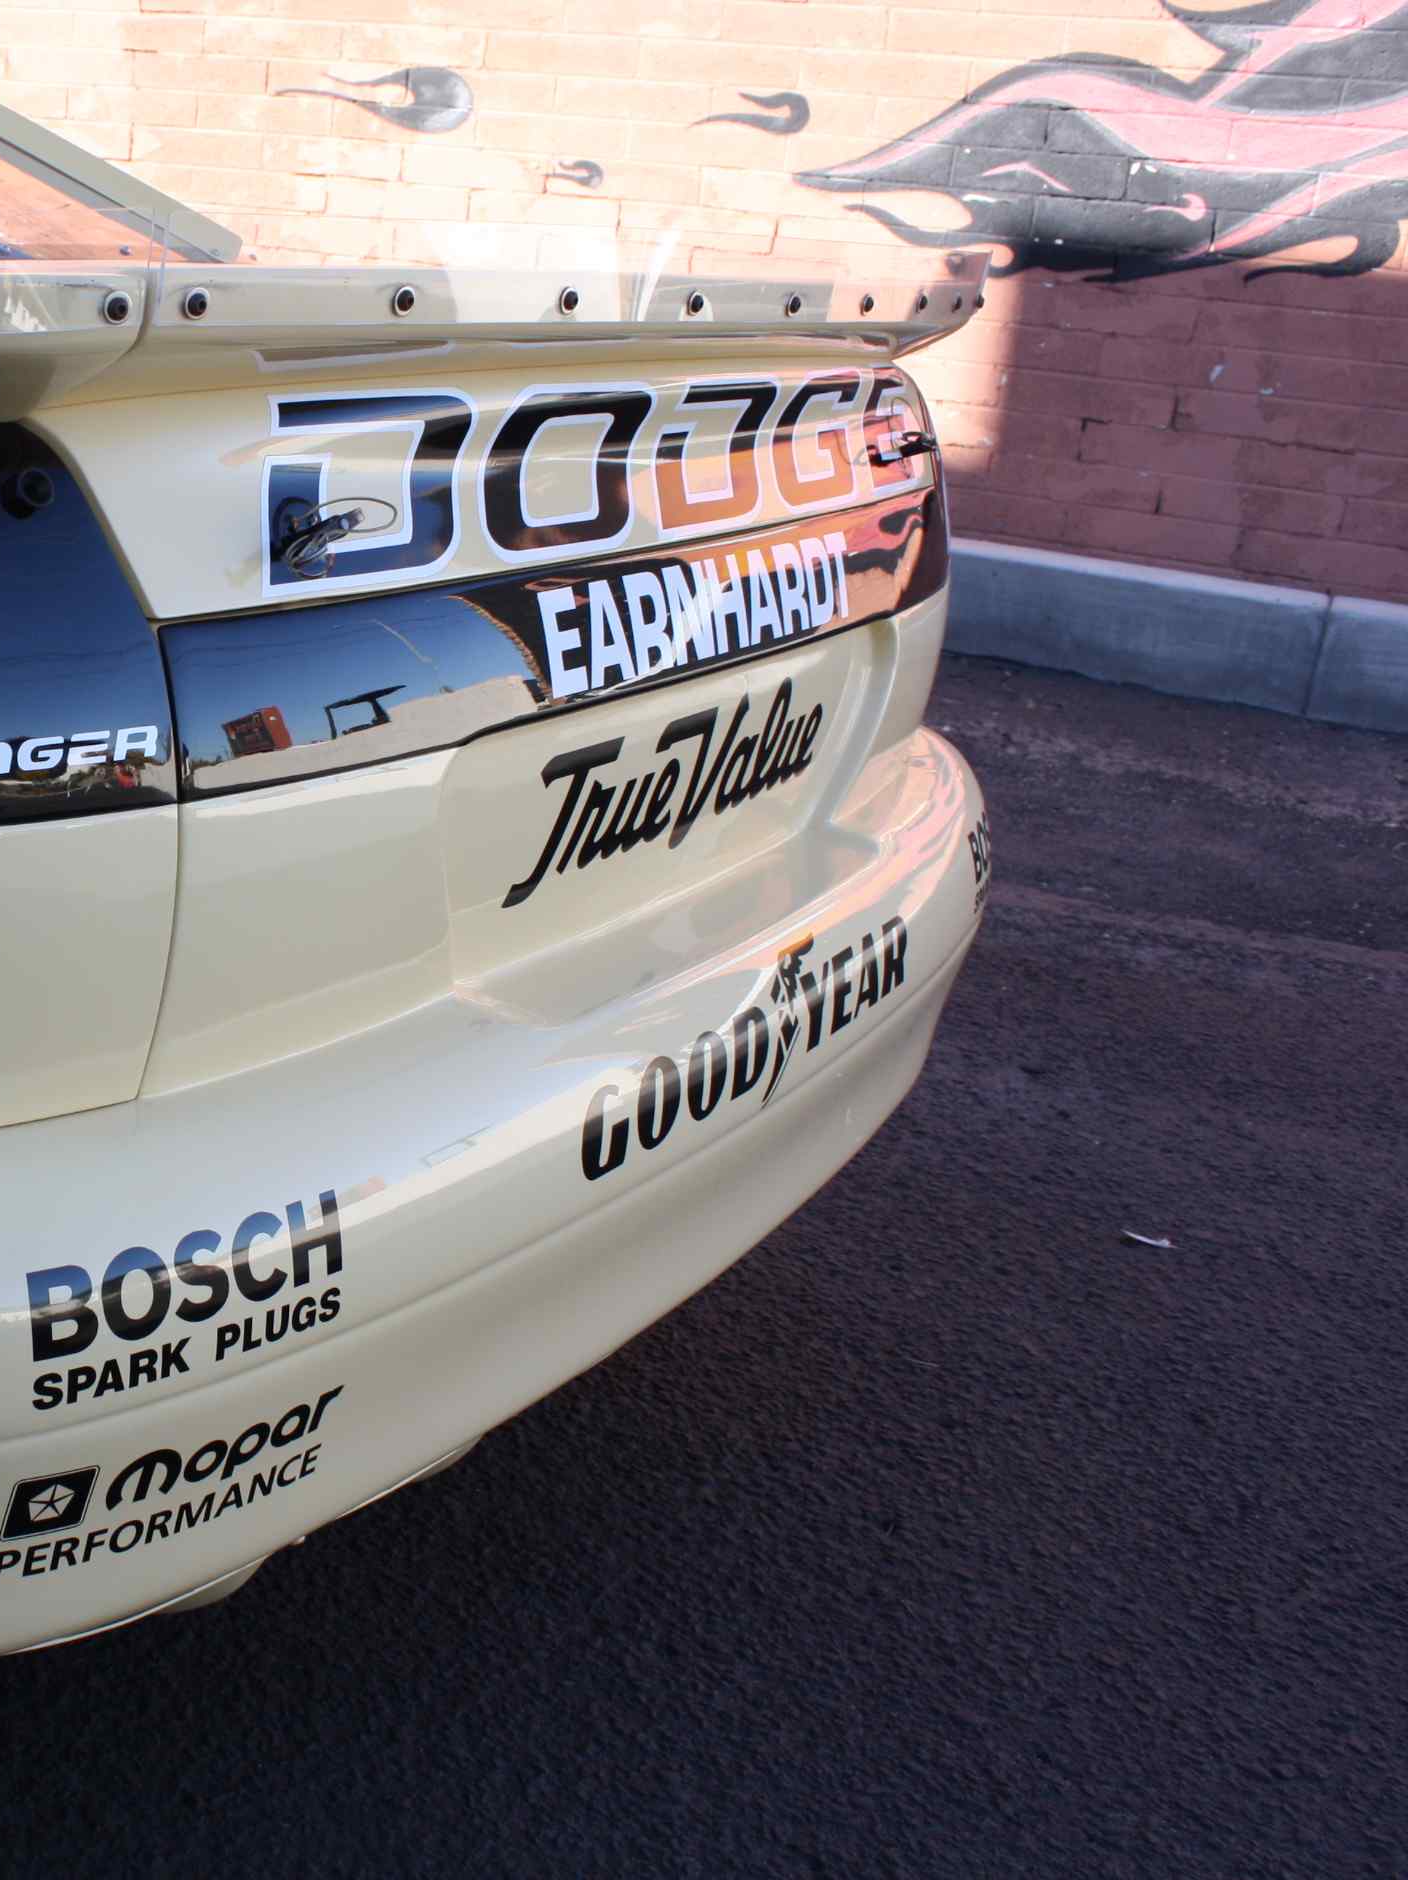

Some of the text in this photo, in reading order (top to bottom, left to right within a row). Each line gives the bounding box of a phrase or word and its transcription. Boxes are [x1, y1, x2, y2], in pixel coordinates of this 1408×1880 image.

[261, 367, 922, 597] DODGE
[536, 531, 849, 699] EARNHARDT
[501, 676, 824, 909] True Value
[581, 915, 908, 1181] GOODYEAR
[25, 1188, 344, 1362] BOSCH
[31, 1286, 342, 1411] SPARK PLUGS
